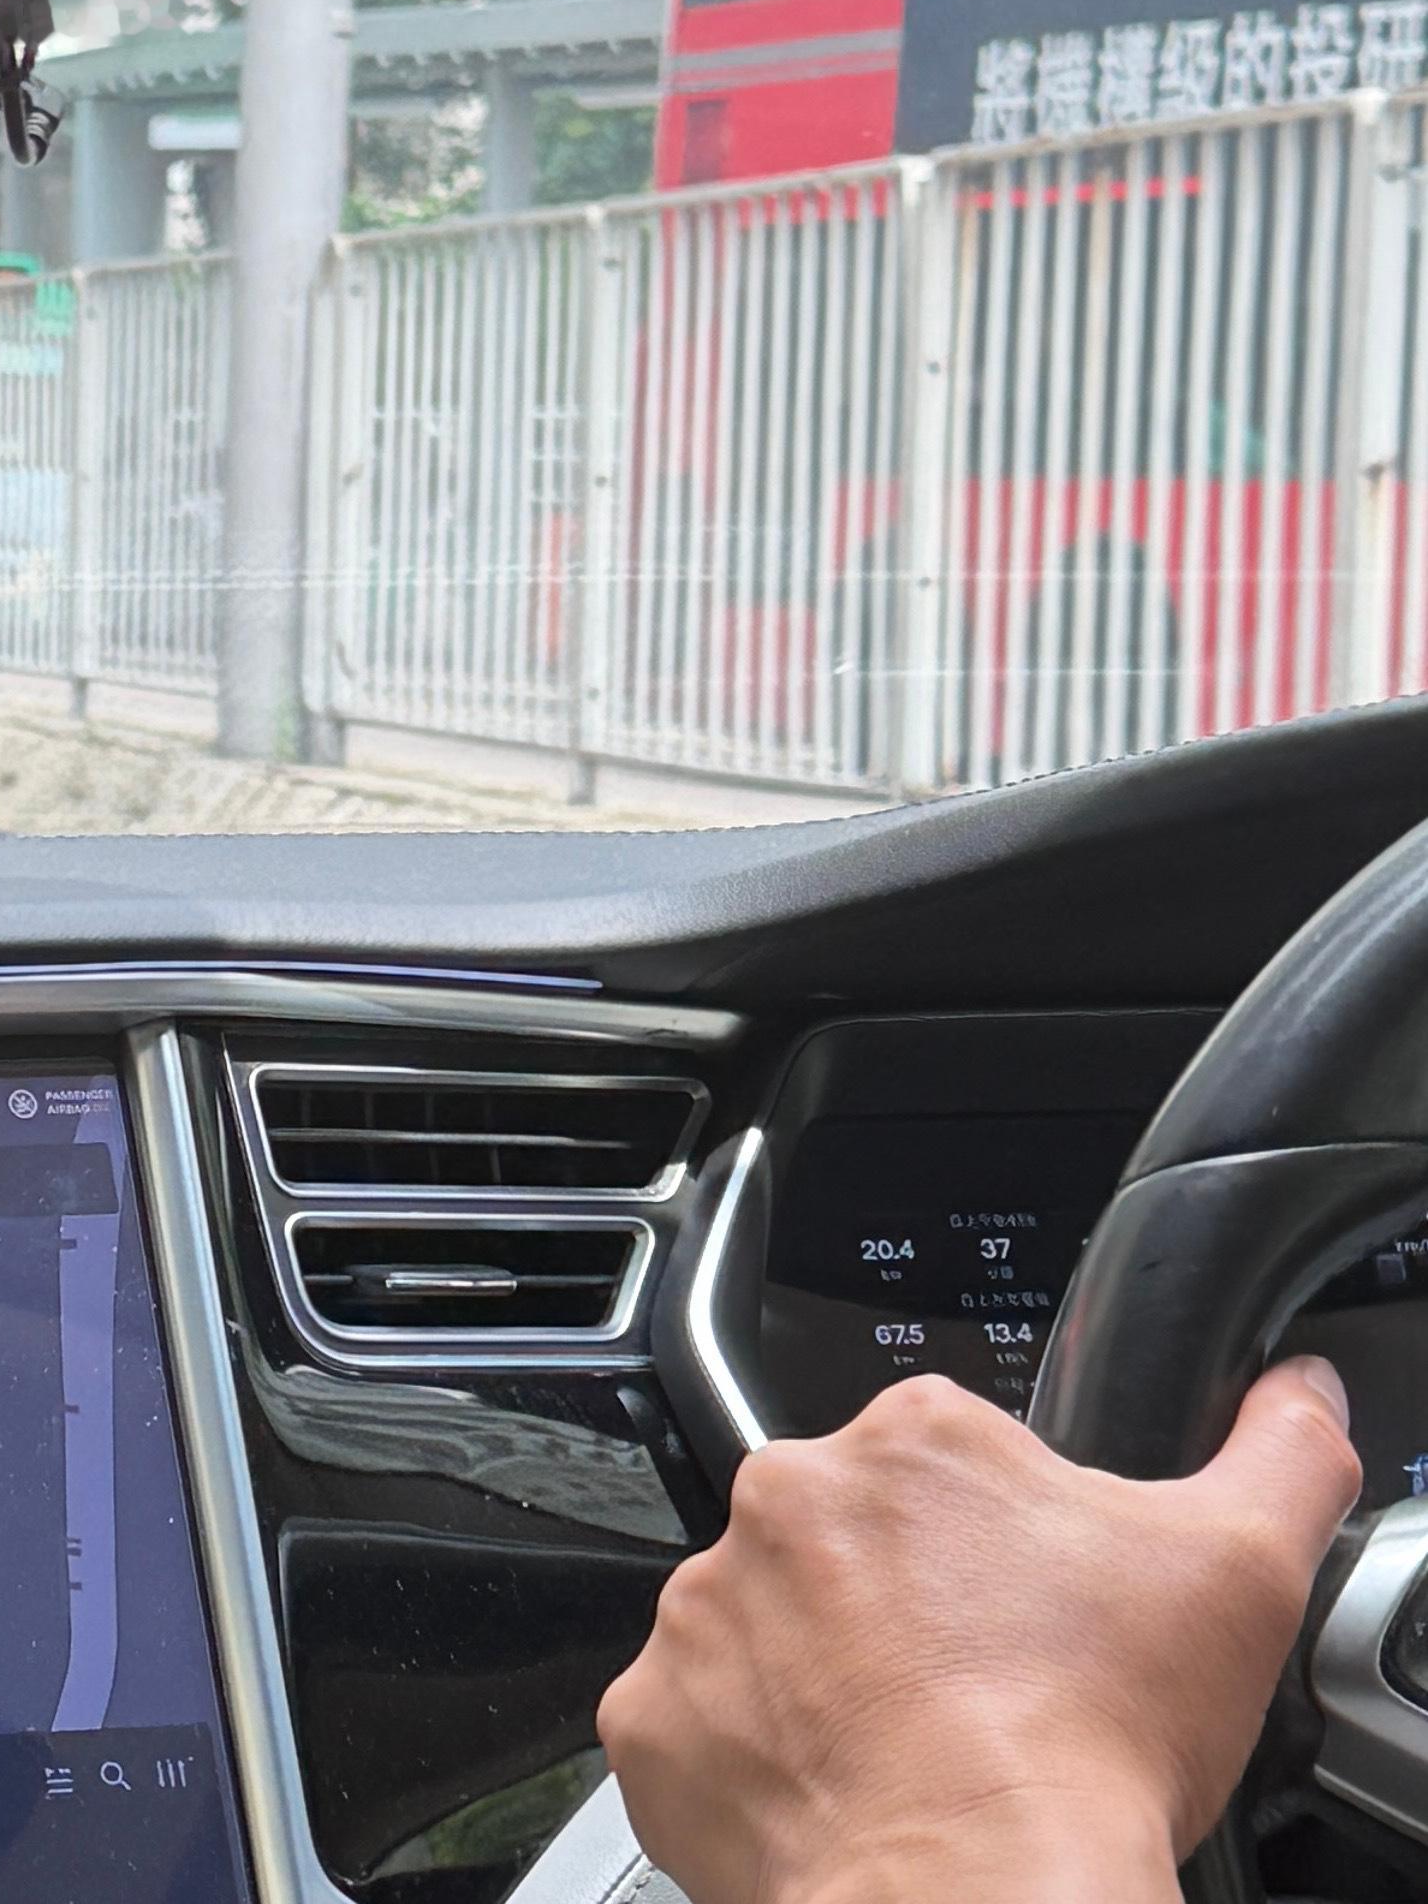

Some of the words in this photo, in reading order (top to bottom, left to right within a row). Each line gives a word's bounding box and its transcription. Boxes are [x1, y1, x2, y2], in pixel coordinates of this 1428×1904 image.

[860, 1239, 915, 1261] 20.4
[980, 1238, 1011, 1260] 37
[874, 1323, 925, 1346] 67.5
[983, 1322, 1034, 1344] 13.4
